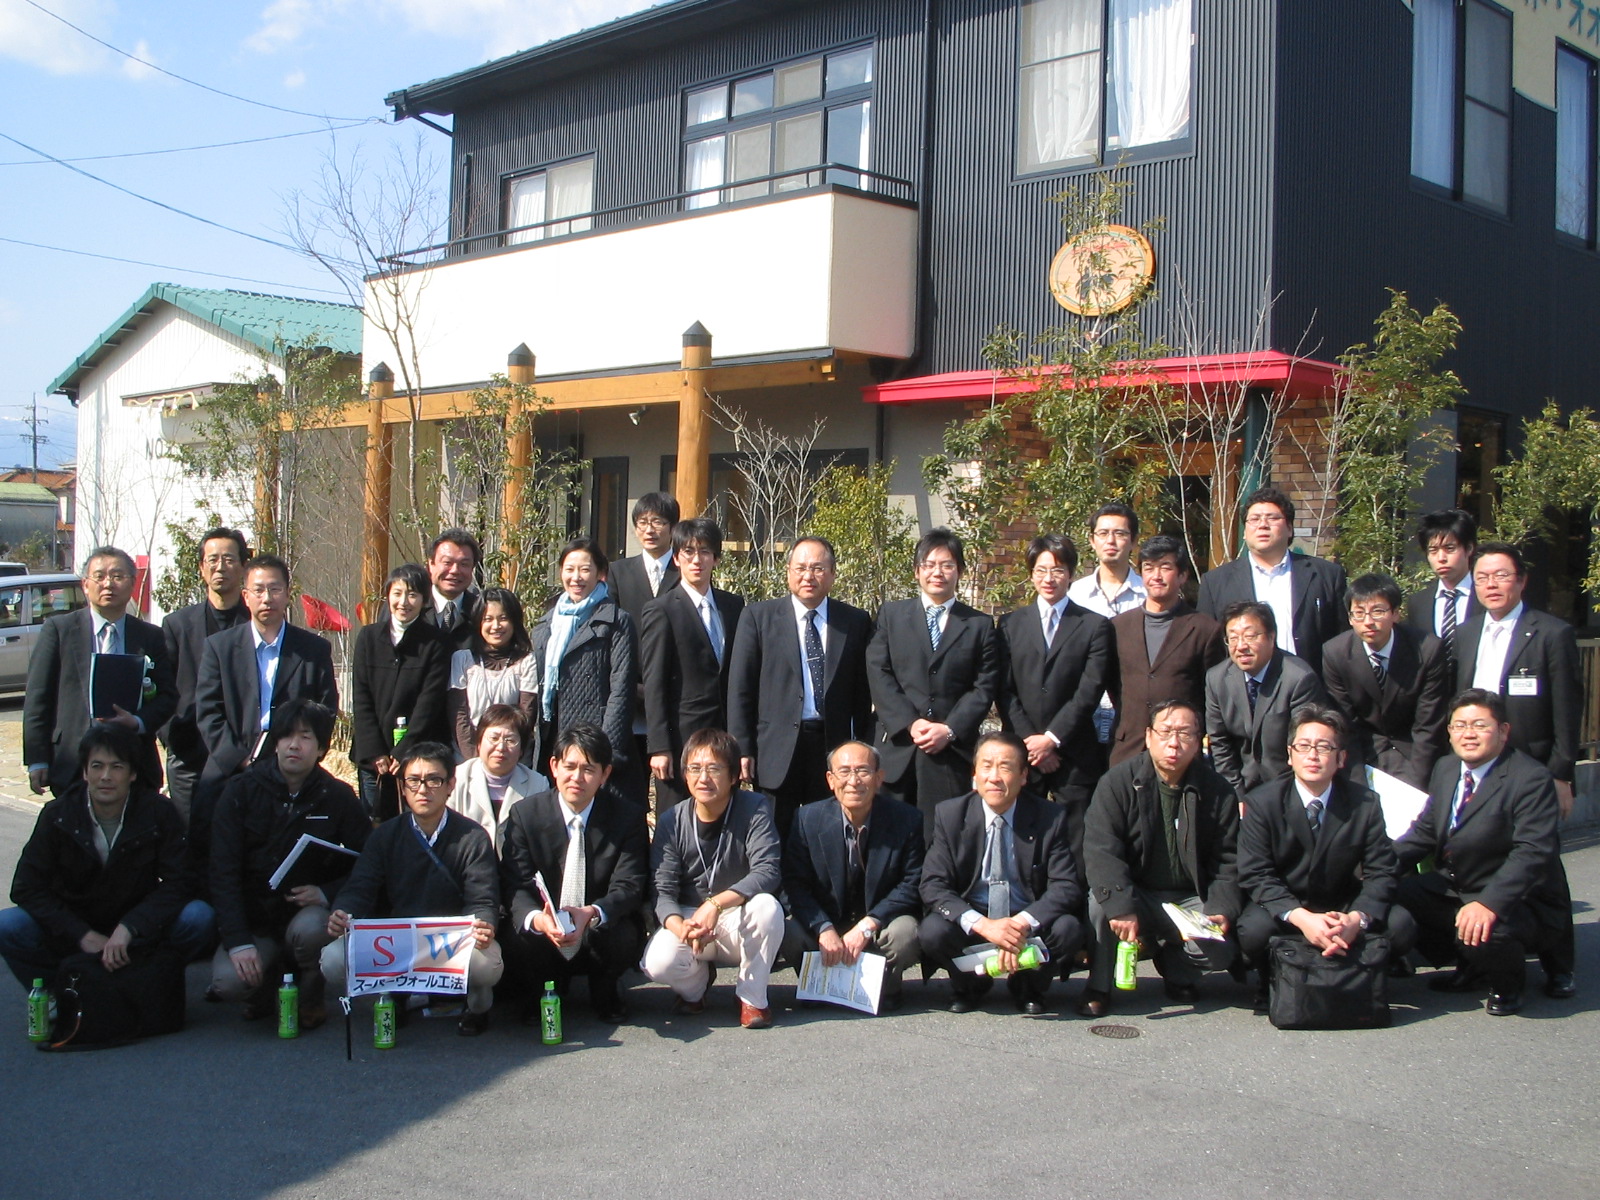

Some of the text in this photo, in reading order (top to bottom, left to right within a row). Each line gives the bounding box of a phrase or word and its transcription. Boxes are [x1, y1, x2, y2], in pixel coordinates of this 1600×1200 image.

[372, 931, 466, 967] S W
[353, 975, 464, 991] スーパーウォール工法
